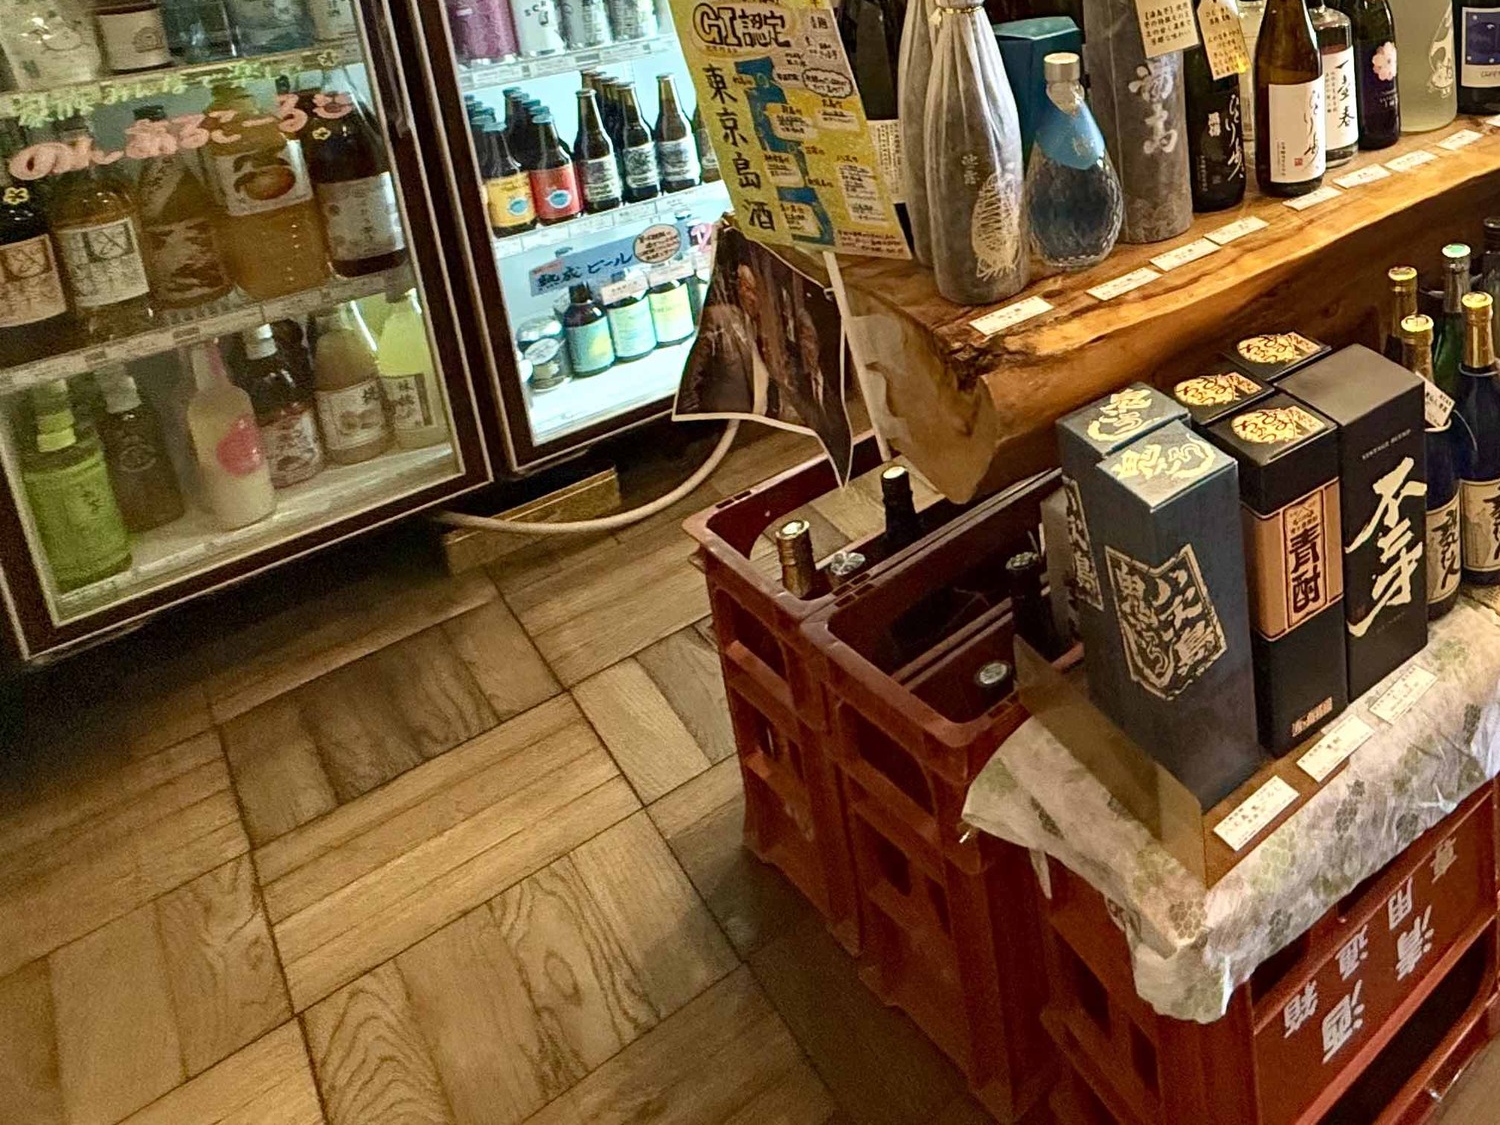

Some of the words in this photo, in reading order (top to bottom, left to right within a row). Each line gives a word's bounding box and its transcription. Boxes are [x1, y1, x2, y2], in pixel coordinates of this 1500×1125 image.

[702, 63, 777, 233] 東京島酒
[587, 250, 633, 274] ビール
[1289, 523, 1321, 615] 青酎
[1321, 903, 1435, 1065] 清酒
